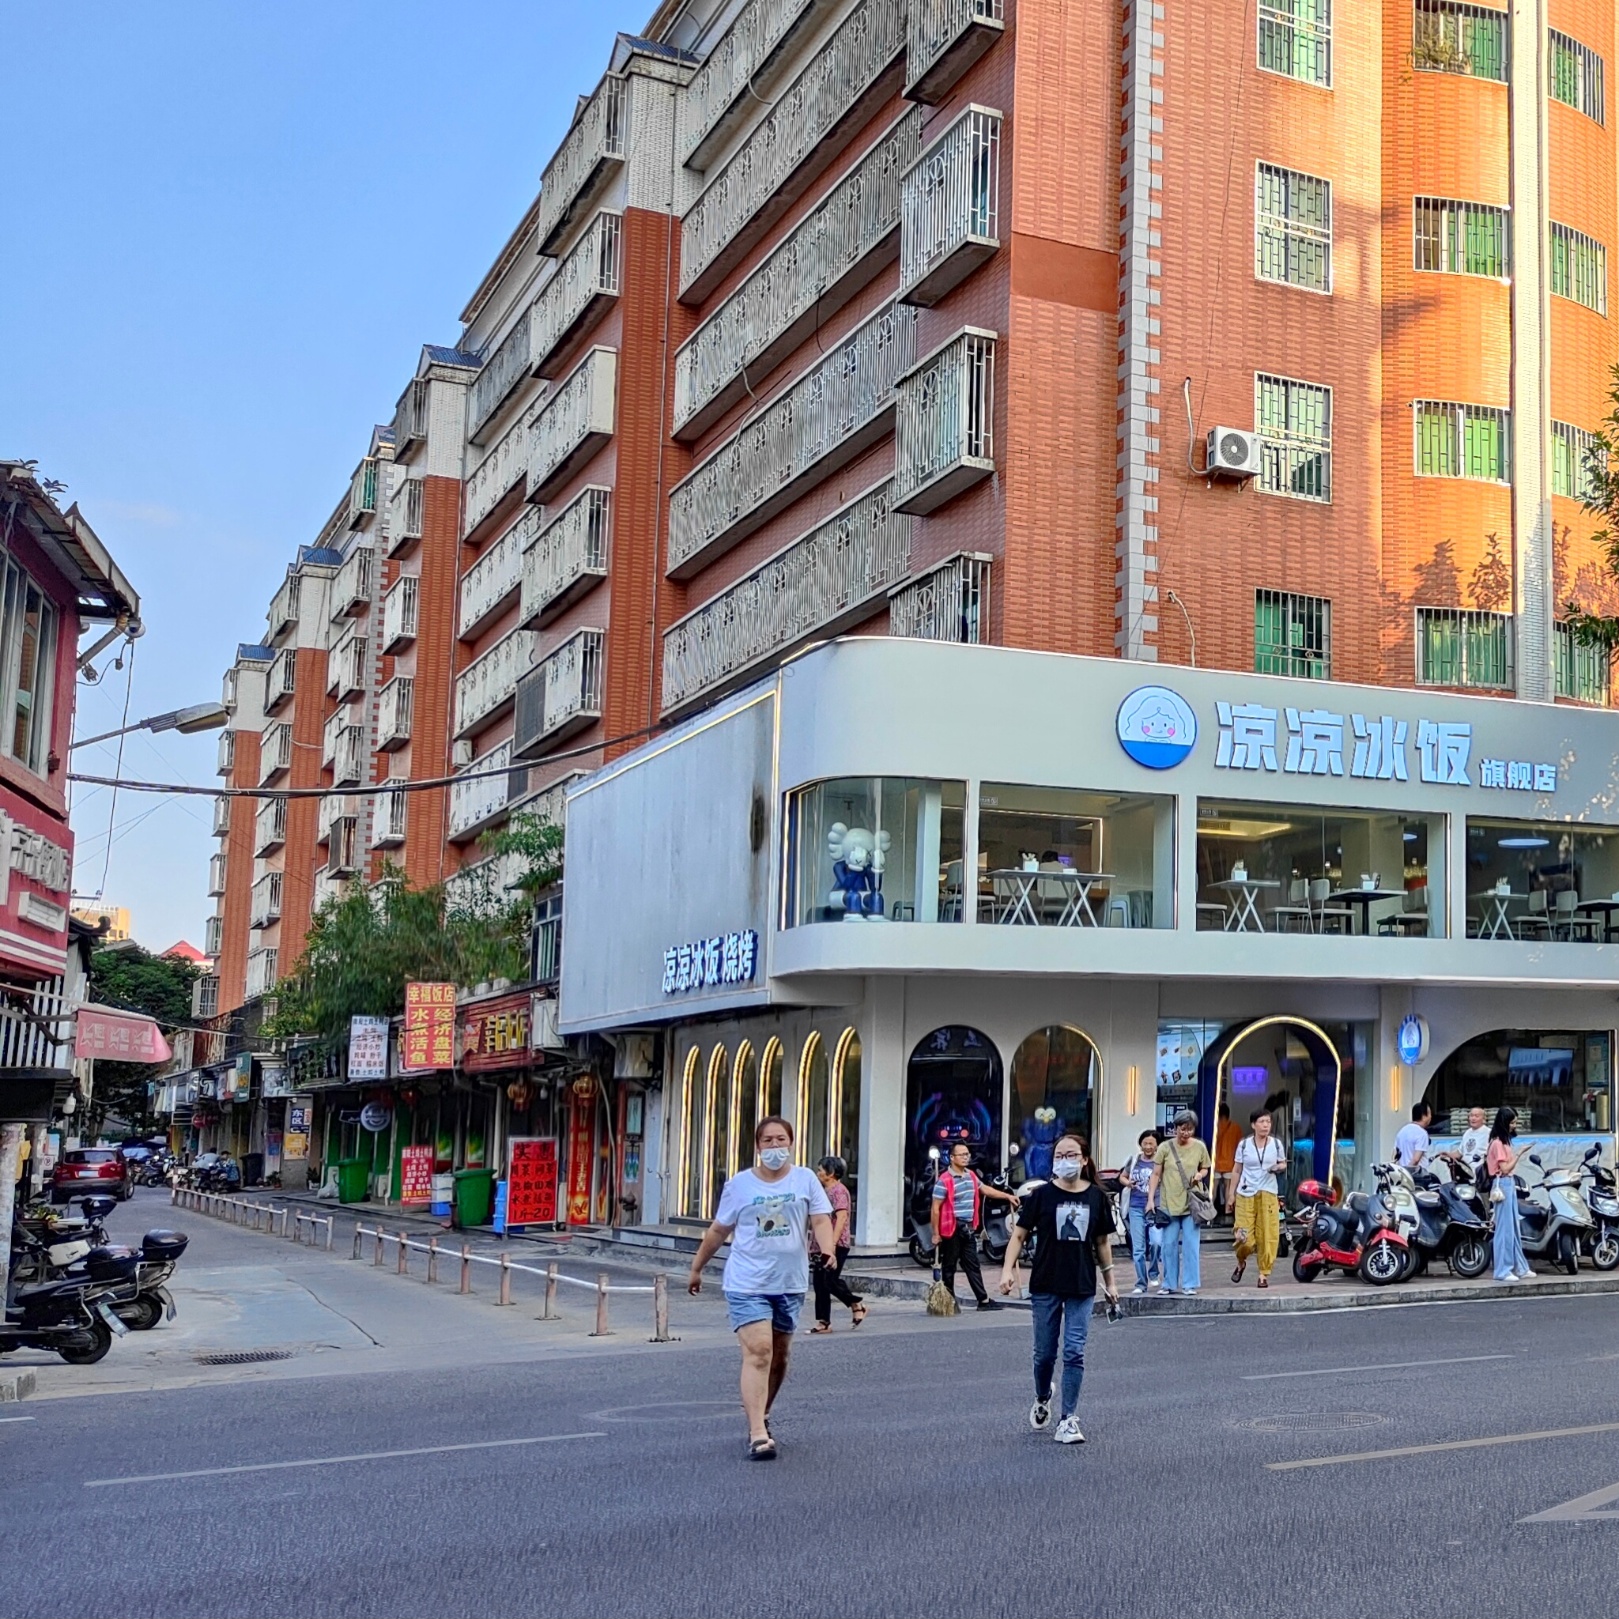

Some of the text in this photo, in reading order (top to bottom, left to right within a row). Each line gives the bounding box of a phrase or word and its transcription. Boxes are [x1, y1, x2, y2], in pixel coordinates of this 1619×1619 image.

[1215, 701, 1556, 792] 凉凉冰饭 旗舰店
[662, 929, 756, 993] 凉凉冰饭烧烤
[409, 986, 454, 1003] 幸福饭店
[410, 1007, 429, 1065] 水煮活鱼
[433, 1007, 453, 1064] 经济盘菜
